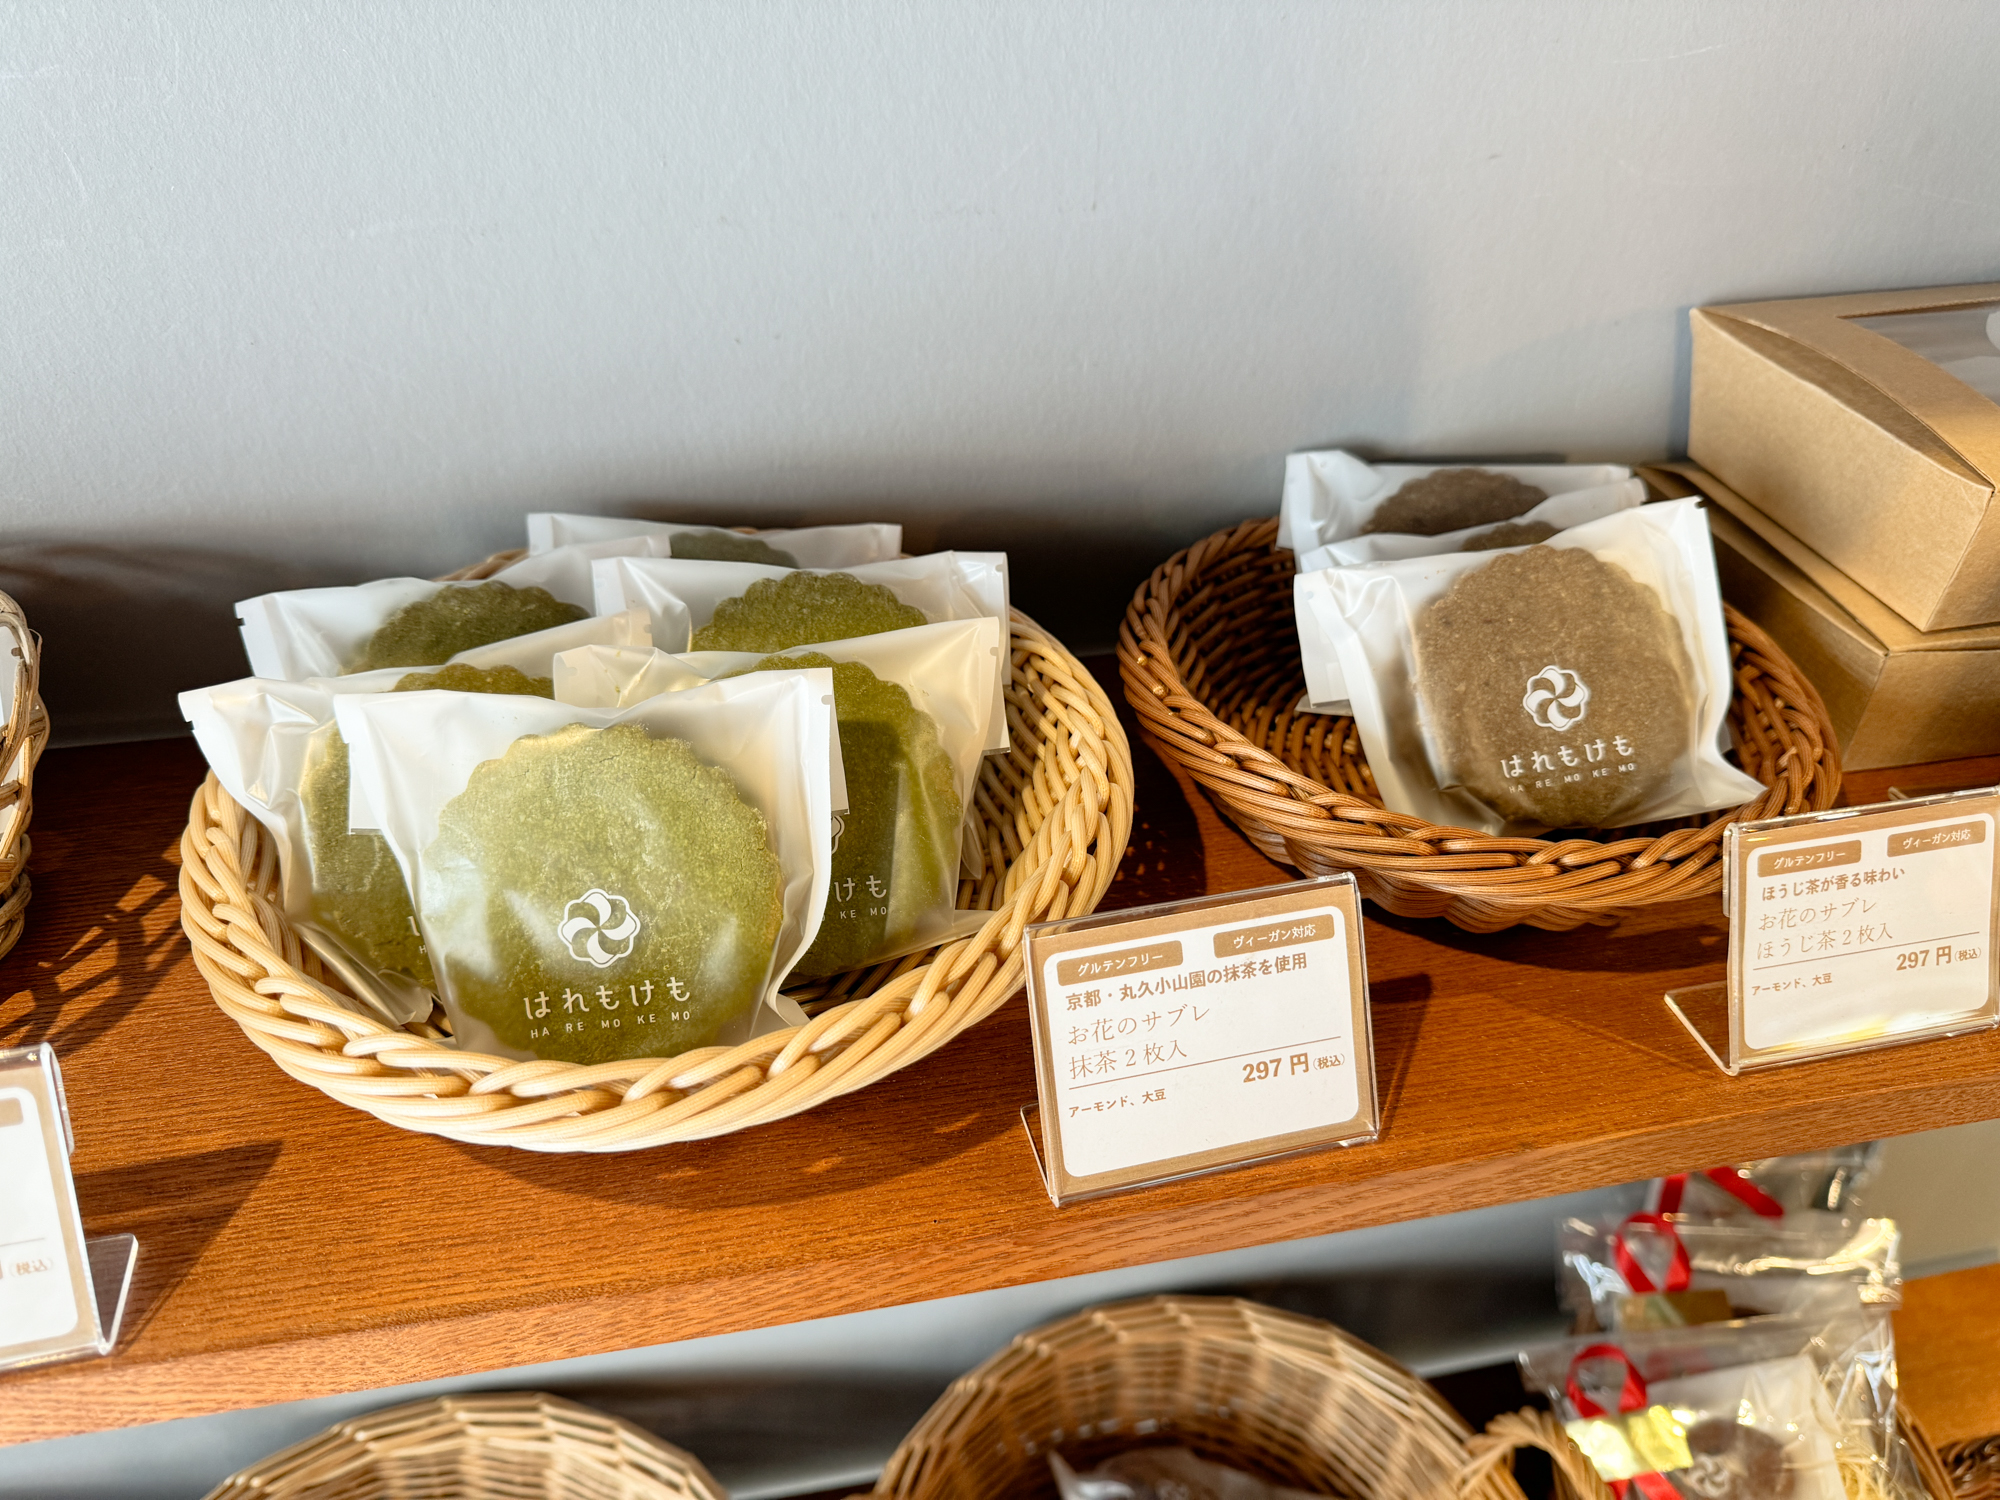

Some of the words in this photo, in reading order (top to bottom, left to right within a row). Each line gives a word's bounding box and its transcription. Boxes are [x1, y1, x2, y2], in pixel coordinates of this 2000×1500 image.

[1500, 735, 1634, 779] はれもけも
[1508, 784, 1524, 794] HA
[1535, 779, 1552, 789] RE
[1563, 773, 1580, 783] MO
[1592, 768, 1608, 778] KE
[1618, 763, 1635, 773] MO
[1903, 828, 1971, 850] ヴィーガン対応
[1773, 851, 1847, 870] グルテンフリー
[1761, 866, 1905, 902] ほうじ茶が香る味わい
[840, 910, 857, 919] KE
[870, 906, 887, 916] MO
[1758, 897, 1877, 931] お花のサブレ
[1233, 923, 1316, 949] ヴィーガン対応
[1756, 922, 1893, 960] ほうじ茶2枚入
[1077, 952, 1163, 977] グルテンフリー
[1066, 952, 1307, 1011] 京都・丸久小山園の抹茶を使用
[1751, 972, 1833, 996] アーモンド、大豆
[523, 976, 691, 1020] はれもけも
[530, 1027, 551, 1039] HA
[565, 1021, 585, 1033] RE
[601, 1018, 621, 1029] MO
[637, 1013, 657, 1025] KE
[671, 1011, 690, 1021] MO
[1068, 1003, 1211, 1046] お花のサブレ
[1068, 1039, 1188, 1080] 抹茶2枚入
[1068, 1088, 1167, 1118] アーモンド、大豆
